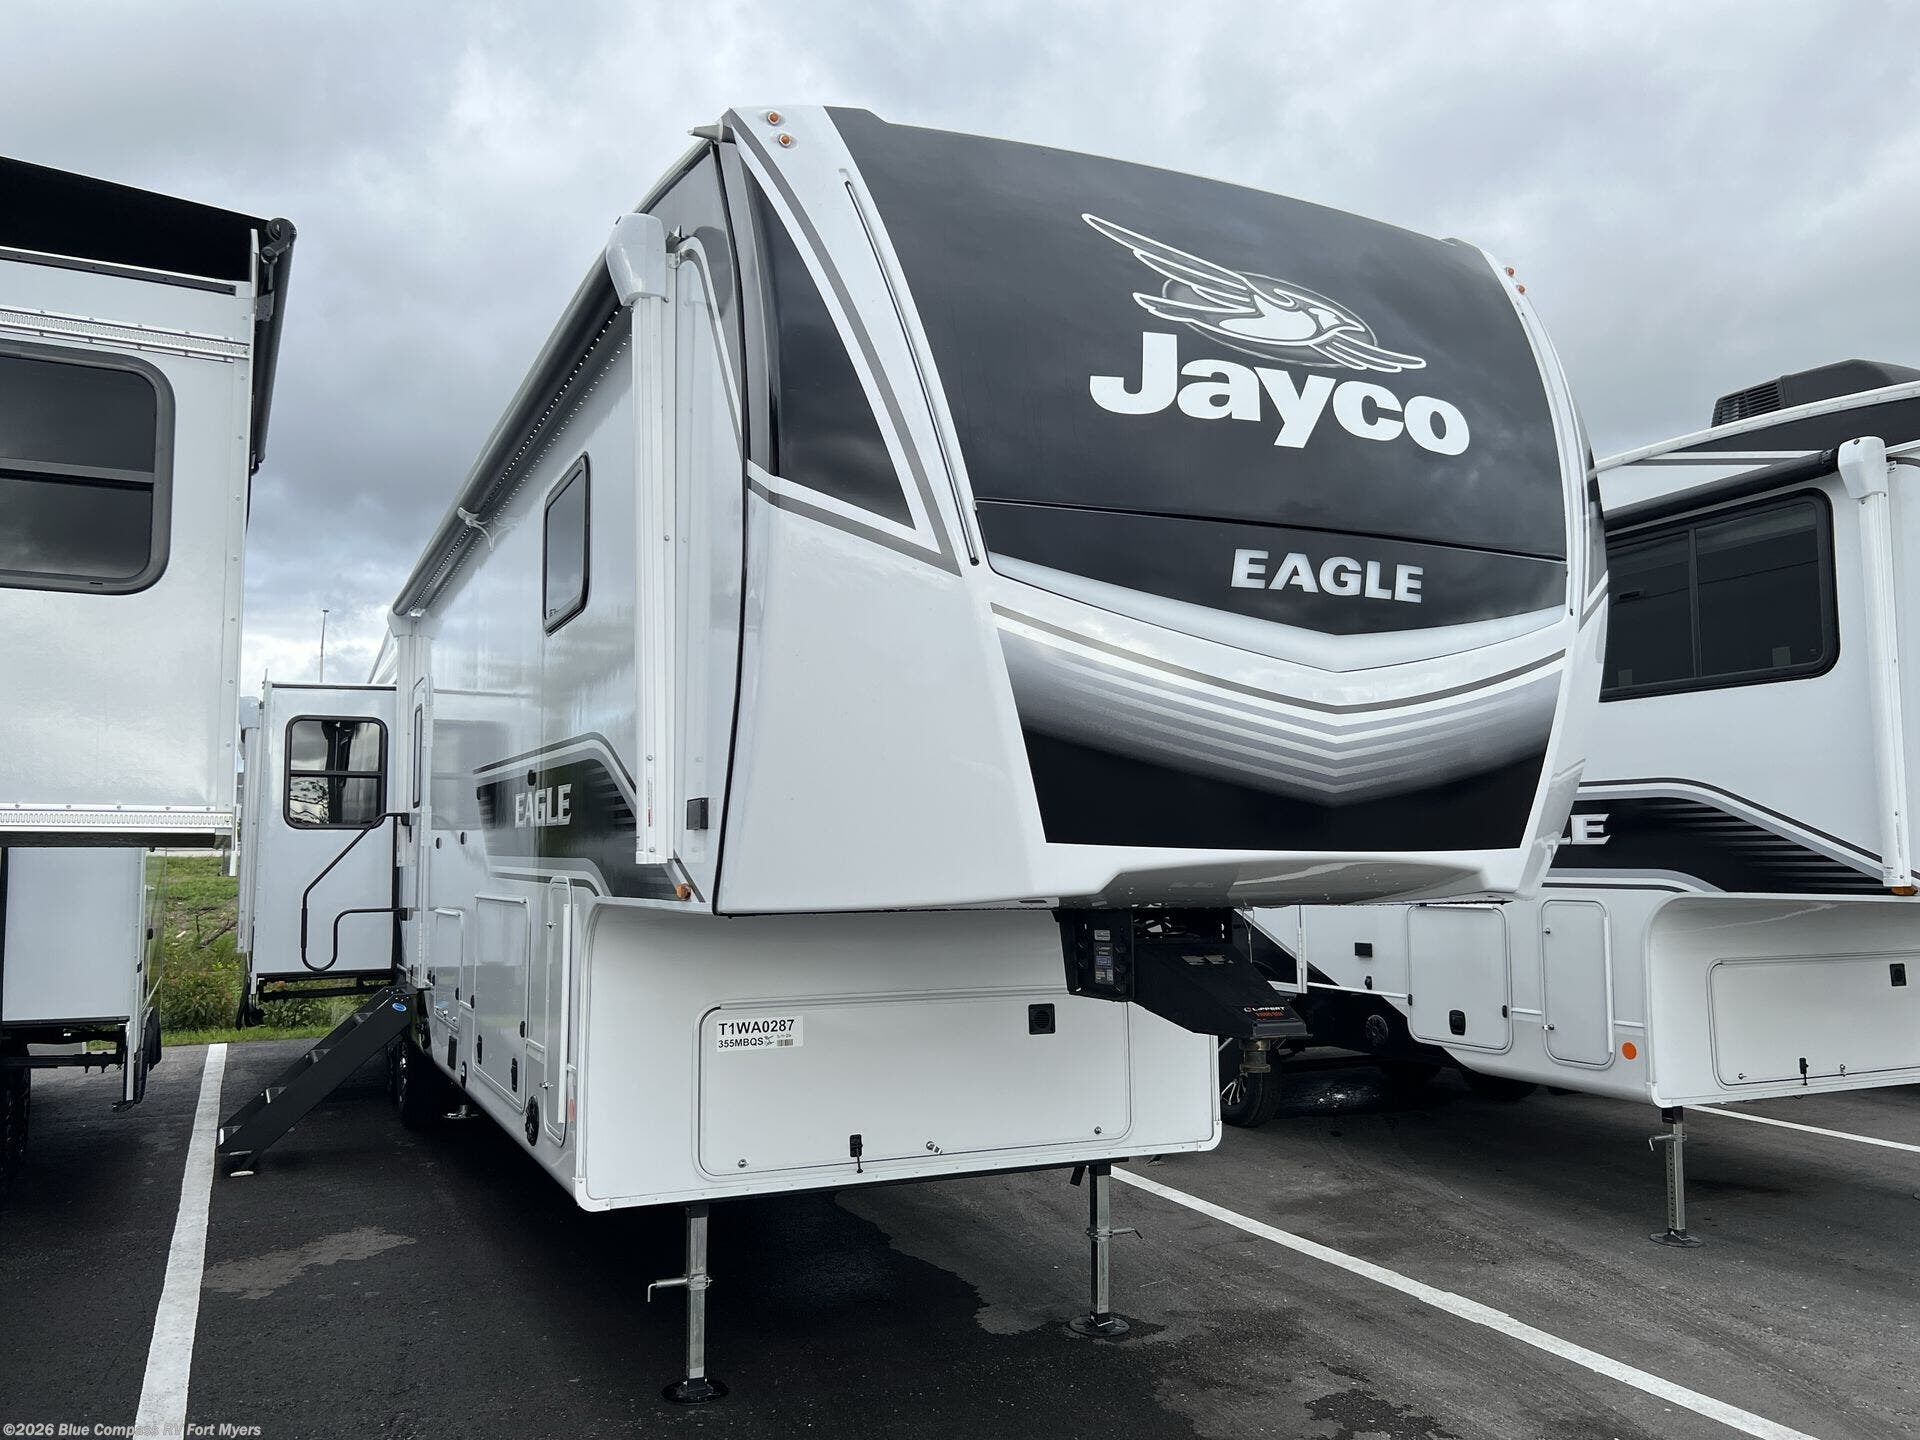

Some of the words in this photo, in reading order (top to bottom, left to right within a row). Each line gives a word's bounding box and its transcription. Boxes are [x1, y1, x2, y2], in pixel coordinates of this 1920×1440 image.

[1089, 331, 1470, 456] Jayco
[1230, 548, 1424, 603] EAGLE
[514, 783, 572, 829] EAGLE
[718, 1019, 795, 1035] T1WA0287
[718, 1037, 764, 1048] 355MBQS
